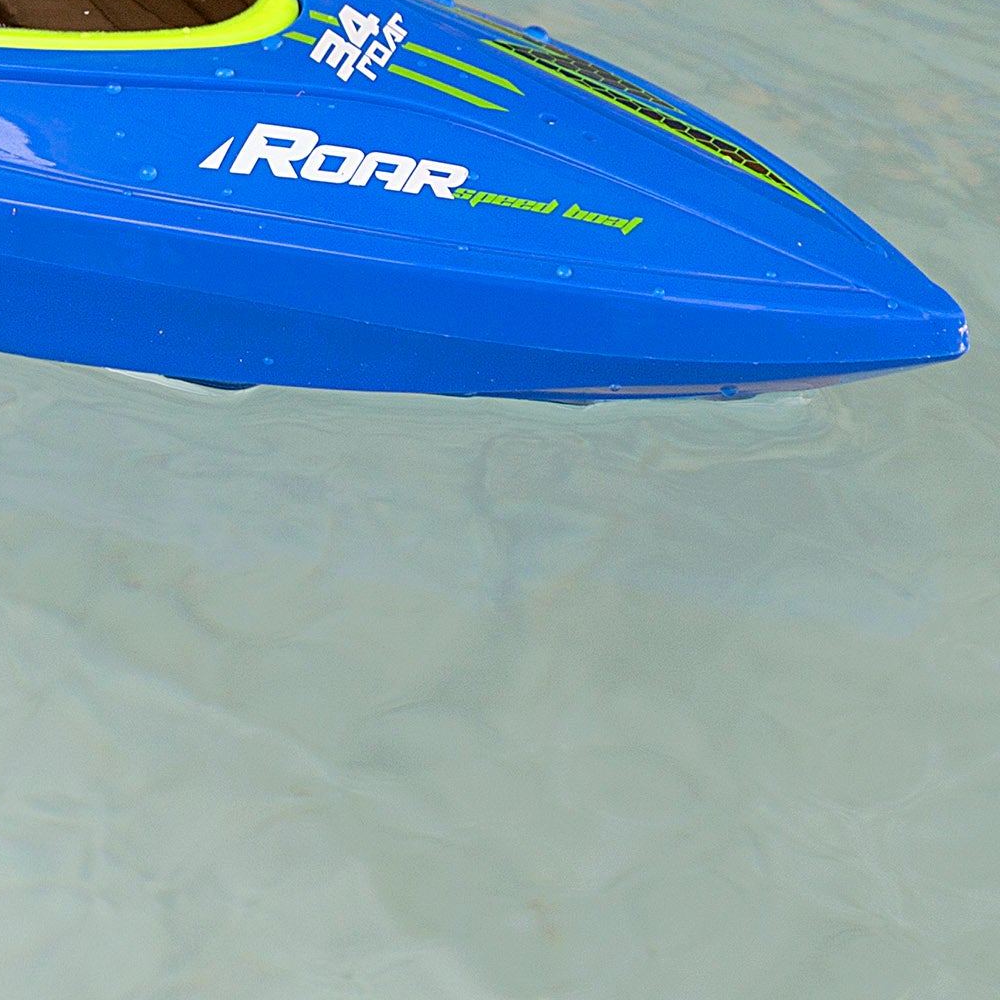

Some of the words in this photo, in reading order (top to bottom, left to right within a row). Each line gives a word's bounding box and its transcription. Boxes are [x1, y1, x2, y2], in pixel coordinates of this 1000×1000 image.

[229, 122, 469, 200] ROAR
[452, 188, 559, 215] speed
[562, 203, 644, 236] boat
